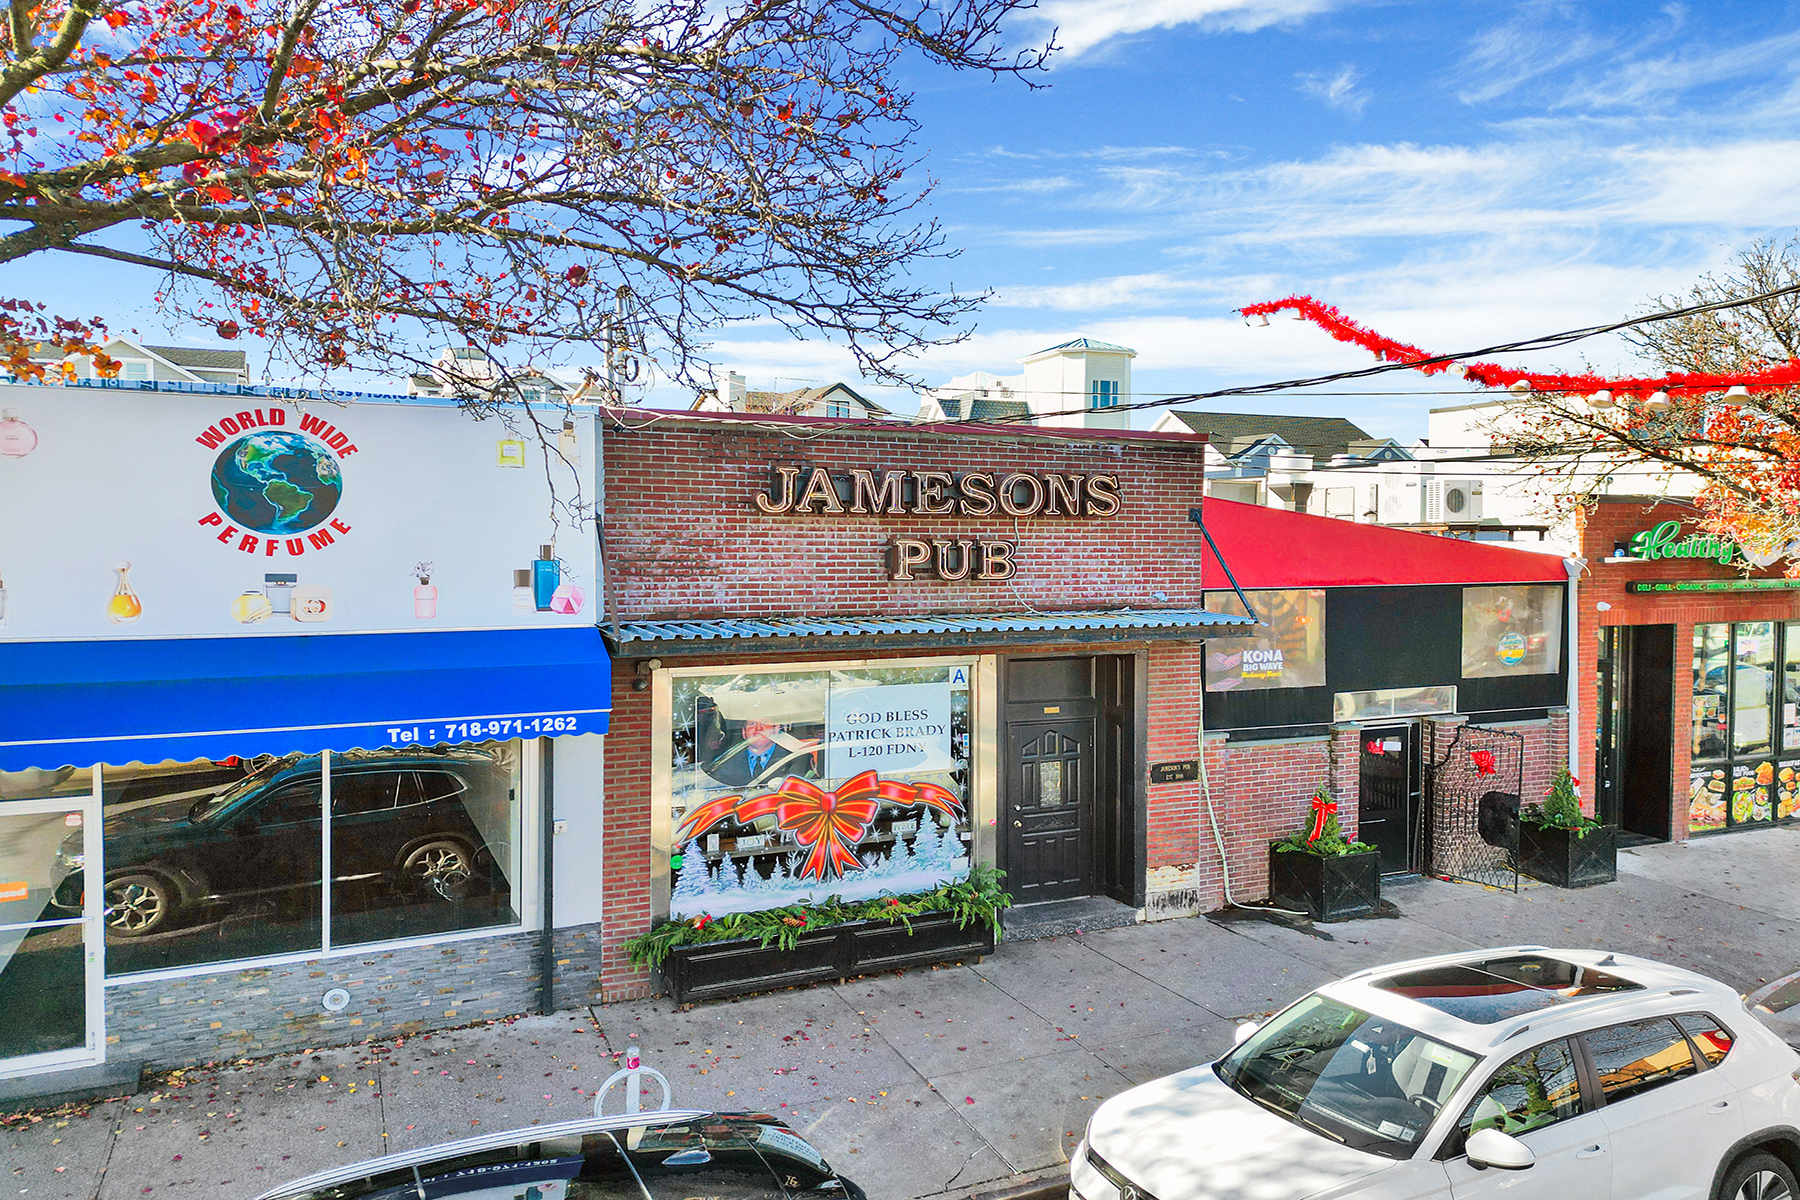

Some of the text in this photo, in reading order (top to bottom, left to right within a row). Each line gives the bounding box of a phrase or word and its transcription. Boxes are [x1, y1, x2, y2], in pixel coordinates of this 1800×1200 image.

[195, 408, 358, 459] WORLD WIDE
[754, 467, 1123, 517] JAMESONS
[198, 512, 352, 556] PERFUME
[1630, 520, 1734, 565] Healthy
[892, 539, 1018, 581] PUB
[1242, 649, 1284, 664] KONA
[1242, 661, 1284, 672] BIG WAVE
[952, 668, 966, 684] A
[846, 709, 929, 725] GOD BLESS
[387, 726, 419, 743] Tel
[444, 716, 578, 739] 718-971-1262
[828, 724, 947, 743] PATRICK BRADY
[848, 742, 927, 759] L-120 FDNY
